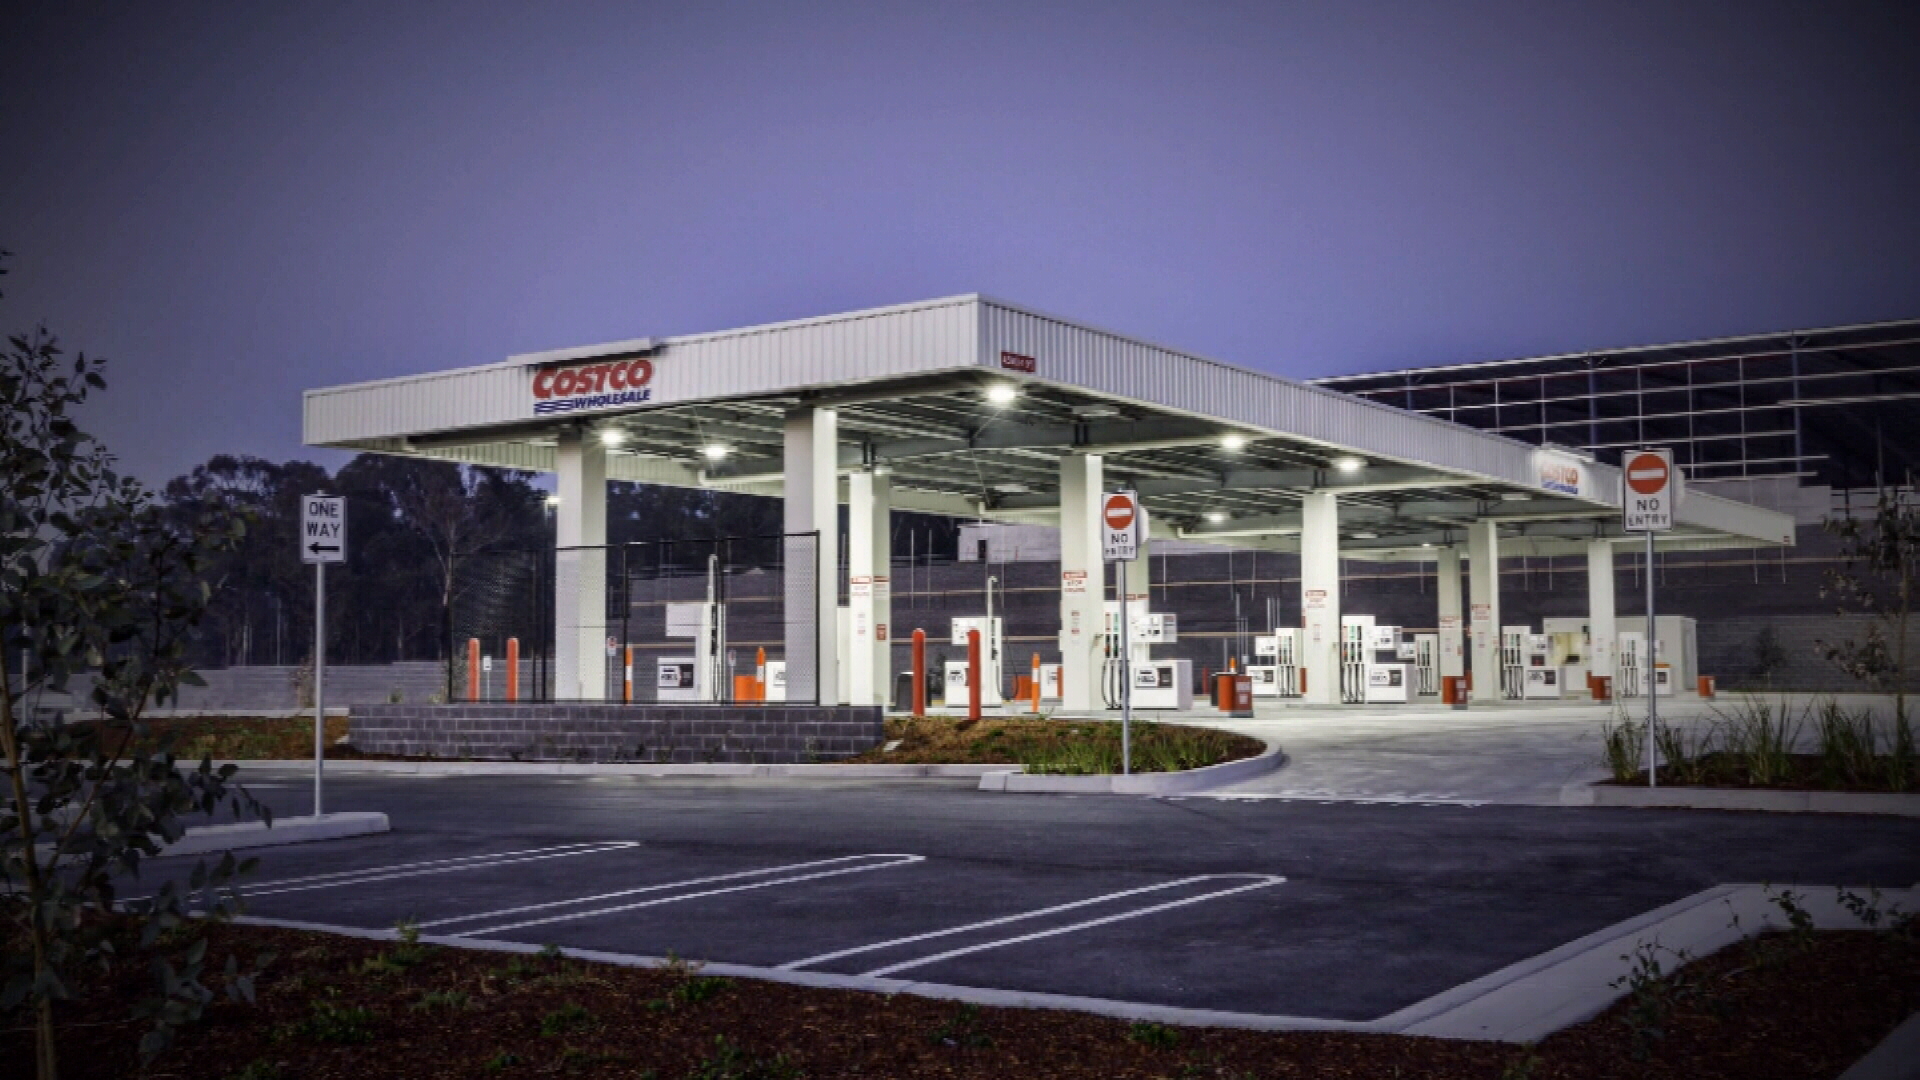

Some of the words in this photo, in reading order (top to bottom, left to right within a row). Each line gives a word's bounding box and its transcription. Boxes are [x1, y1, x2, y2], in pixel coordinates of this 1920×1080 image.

[532, 359, 654, 399] COSTCO
[574, 389, 651, 409] WHOLESALE
[308, 502, 339, 518] ONE
[1636, 498, 1659, 512] NO
[307, 521, 341, 538] WAY
[1111, 533, 1128, 544] NO
